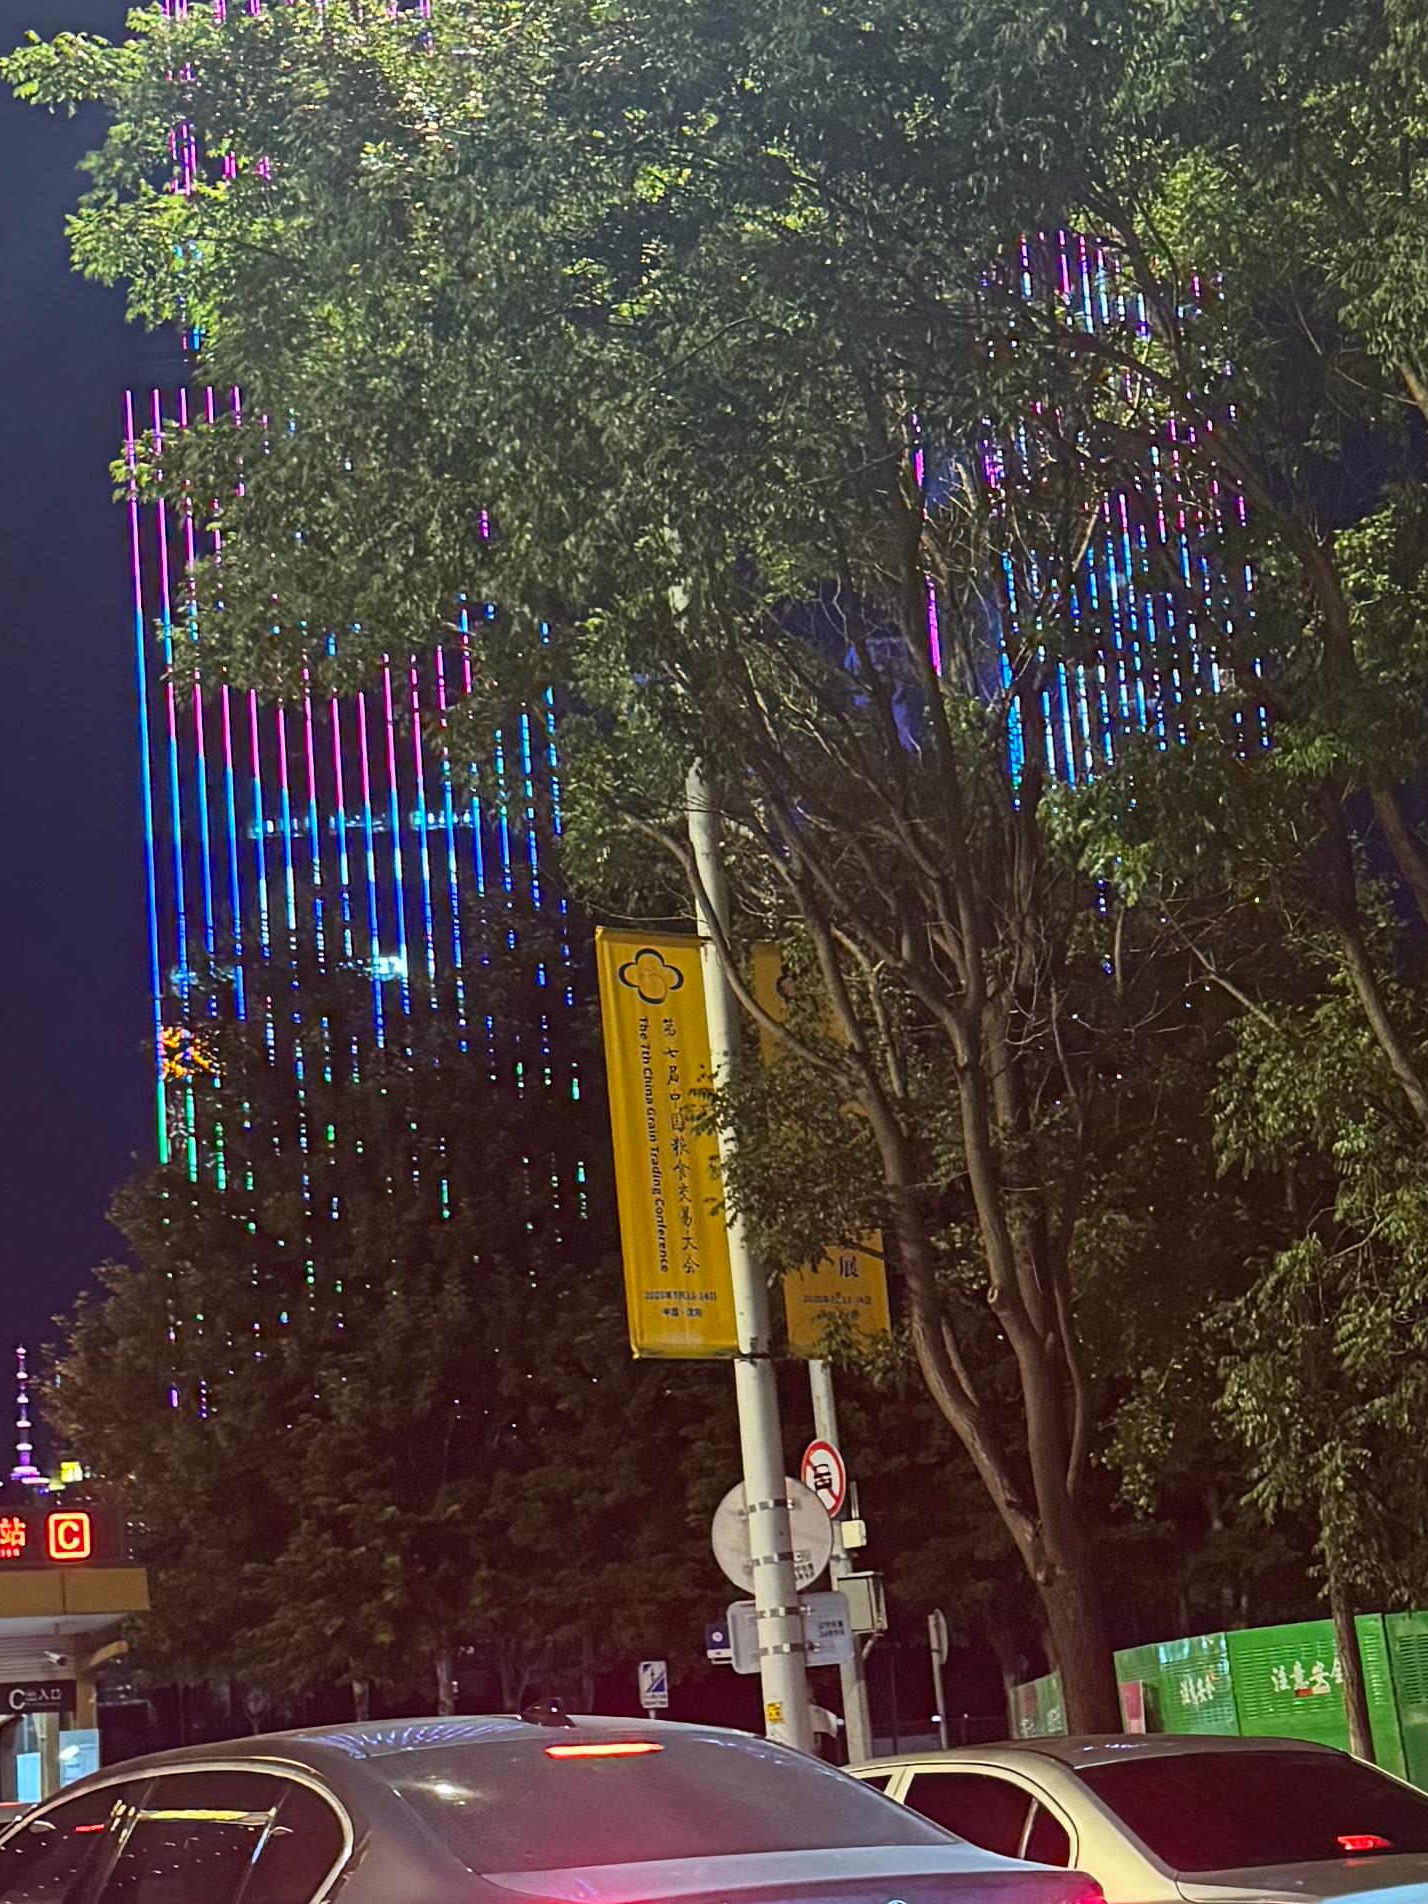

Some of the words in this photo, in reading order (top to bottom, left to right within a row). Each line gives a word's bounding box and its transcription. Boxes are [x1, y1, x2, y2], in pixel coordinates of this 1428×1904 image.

[639, 1017, 649, 1040] The
[641, 1044, 651, 1065] 7th
[643, 1068, 654, 1105] China
[646, 1107, 657, 1142] Grain
[663, 1017, 700, 1274] 第七届中国粮食交易大会
[649, 1145, 662, 1195] Trading
[655, 1198, 668, 1273] Conference
[57, 1521, 80, 1550] C
[9, 1689, 26, 1710] C
